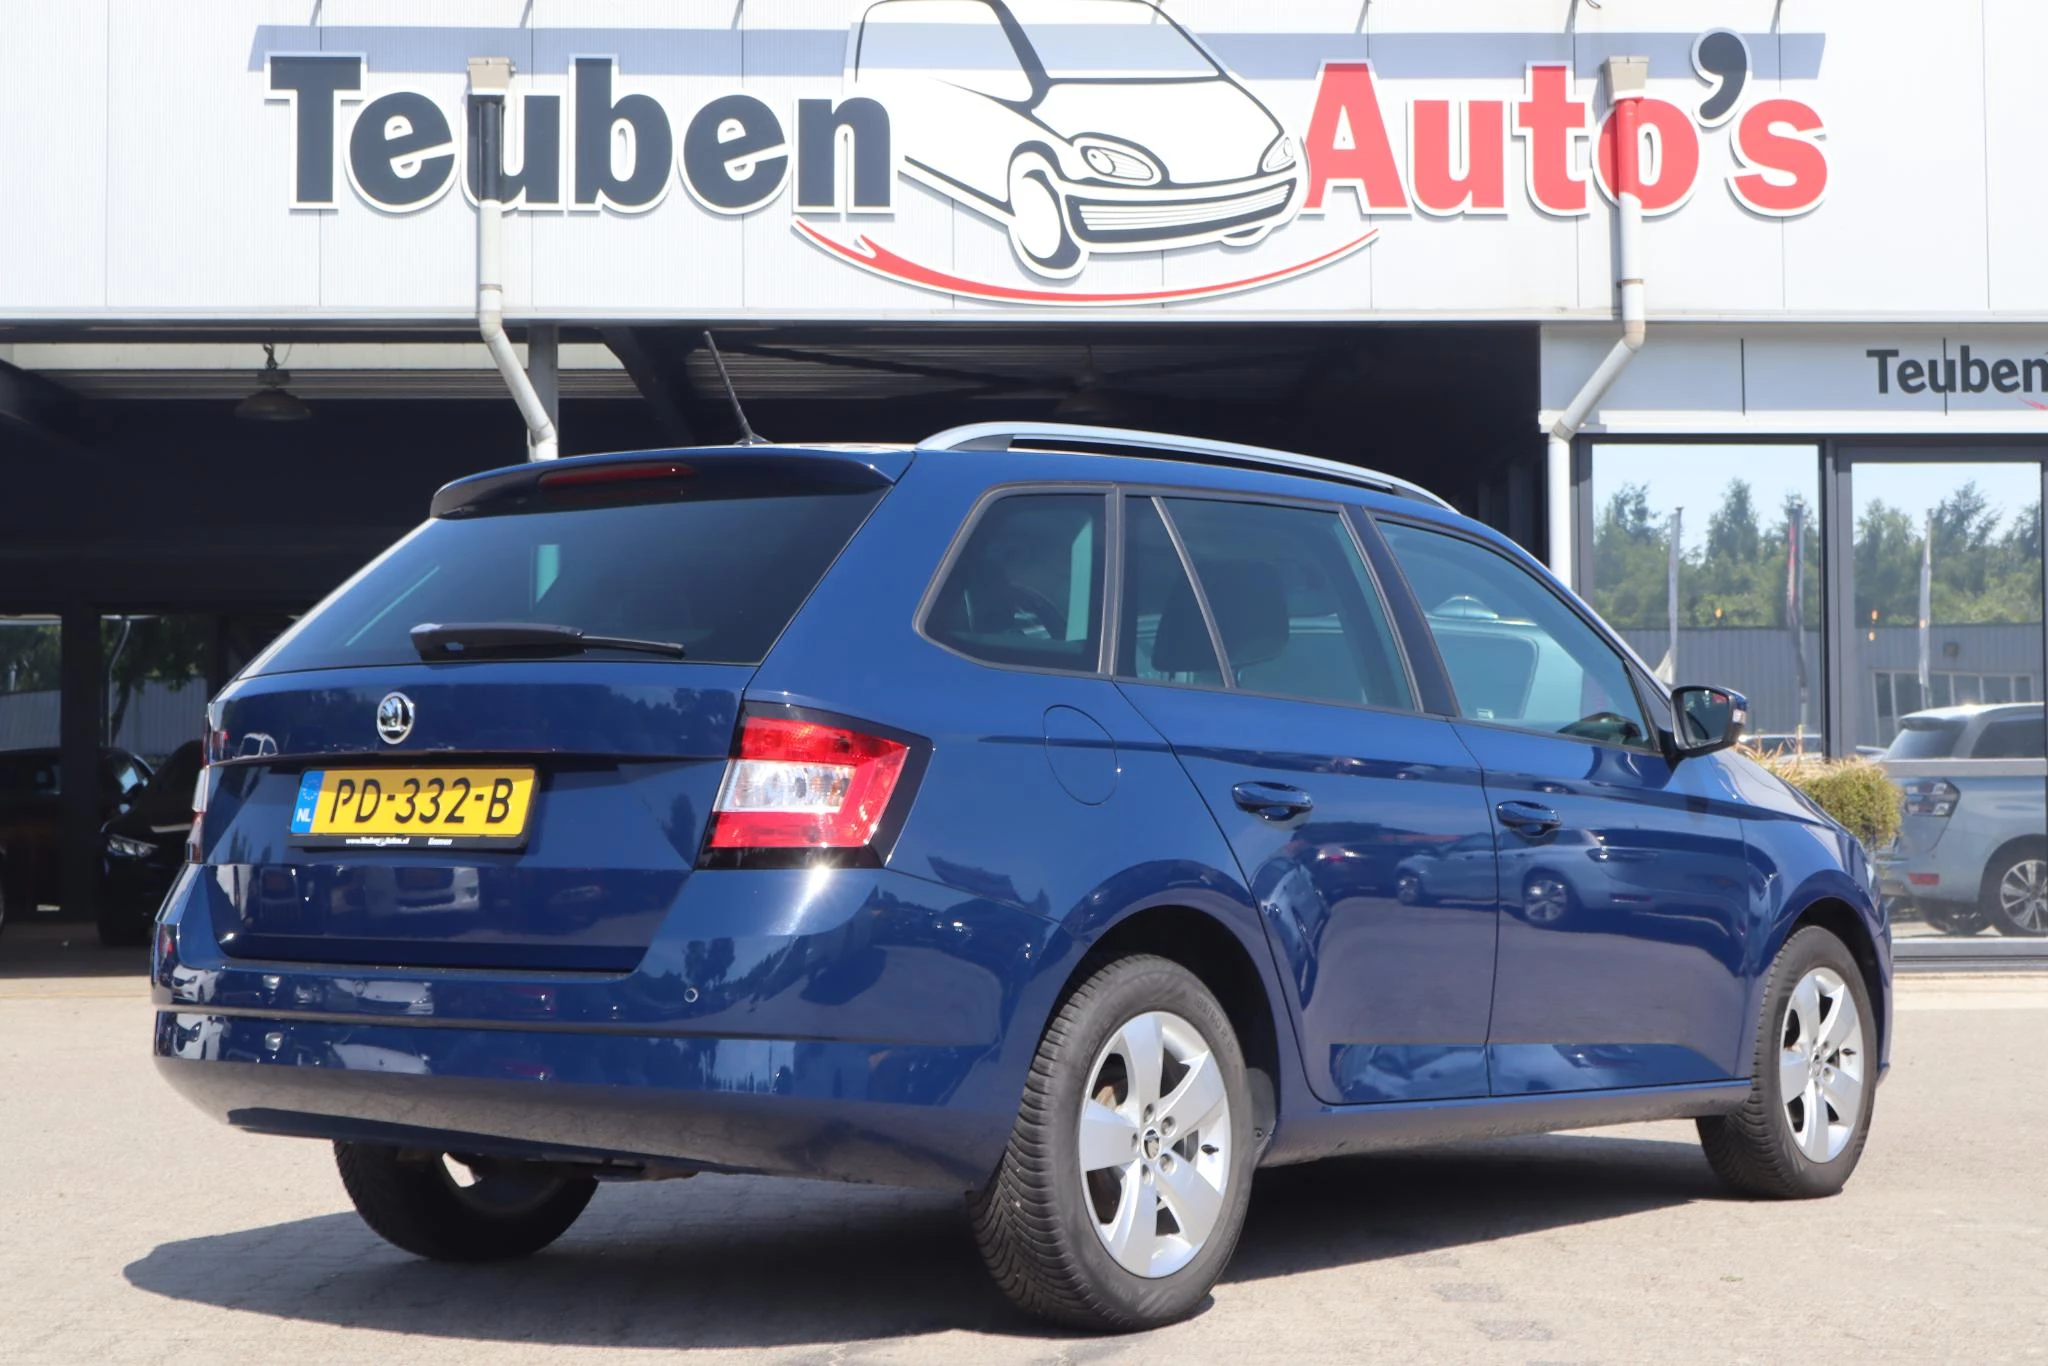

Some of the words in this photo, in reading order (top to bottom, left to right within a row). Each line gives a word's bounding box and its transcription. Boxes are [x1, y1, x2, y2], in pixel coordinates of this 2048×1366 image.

[268, 54, 893, 210] Teuben
[1304, 30, 1829, 211] Auto's
[1865, 344, 2048, 394] Teuben
[296, 807, 313, 823] NL
[329, 776, 514, 824] PD-332-B
